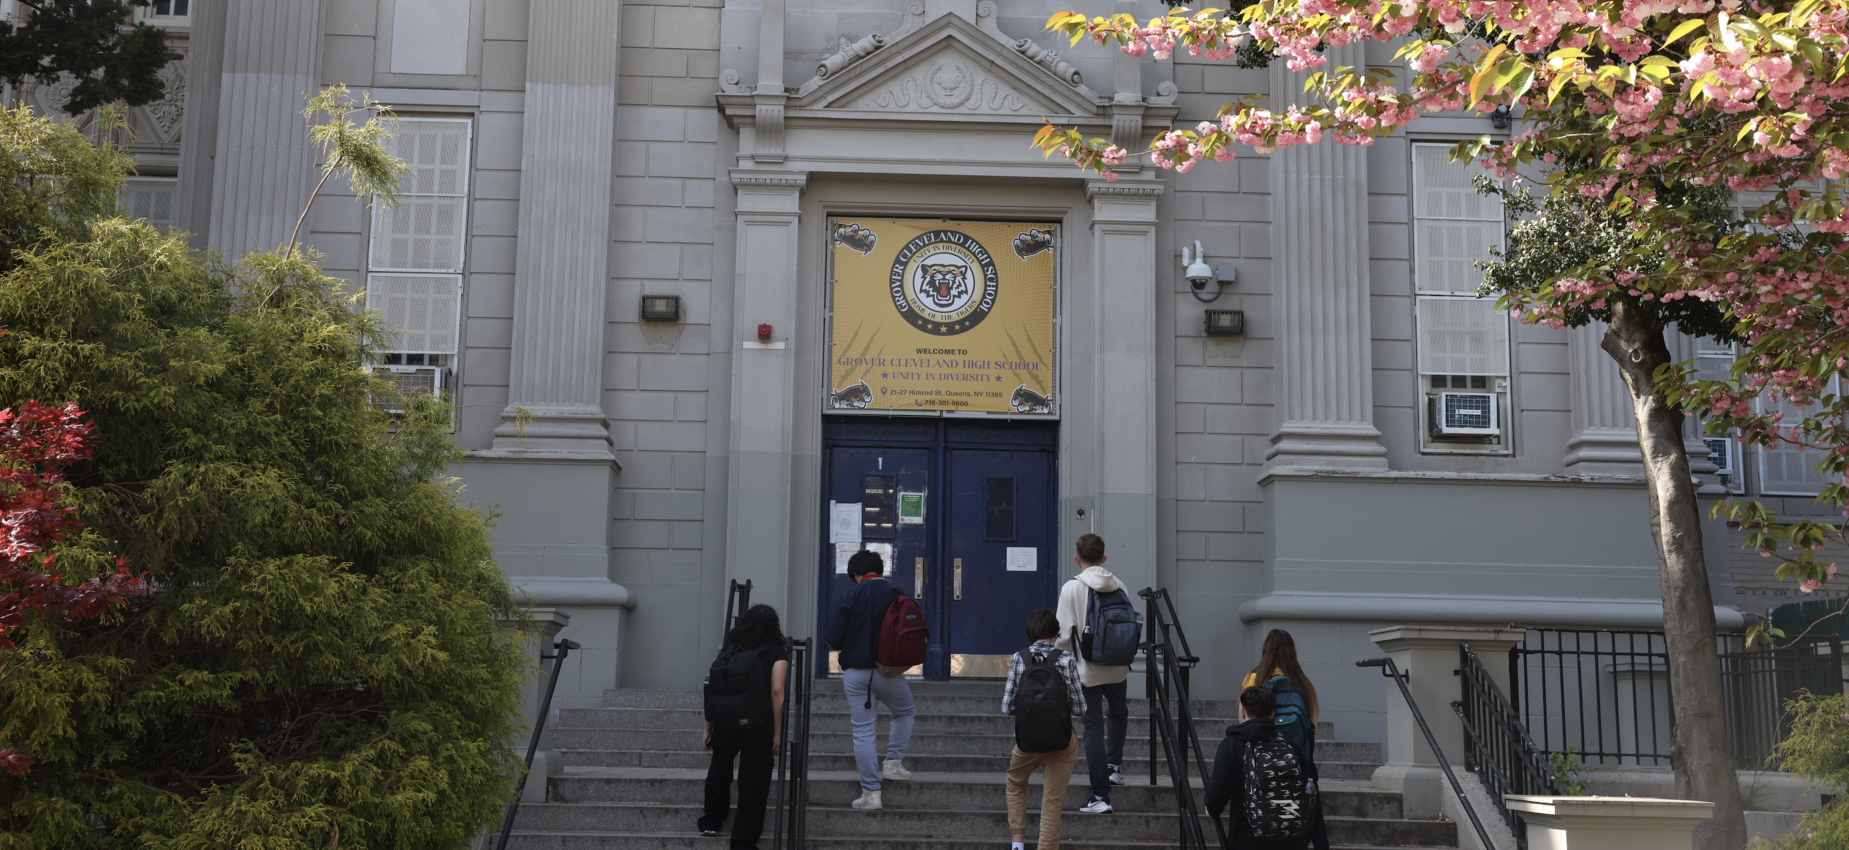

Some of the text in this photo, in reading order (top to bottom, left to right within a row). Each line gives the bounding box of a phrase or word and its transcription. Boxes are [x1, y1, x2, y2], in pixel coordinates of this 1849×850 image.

[913, 246, 932, 263] UNITY
[942, 244, 975, 264] DIVERSITY
[892, 232, 997, 312] GROVER CLEVELAND HIGH SCHOOL
[910, 297, 926, 315] HOME
[956, 300, 977, 318] TIGERS
[838, 357, 1043, 371] GROVER CLEVELAND HIGH SCHOOL
[892, 372, 992, 382] UNITY IN DIVERSITY
